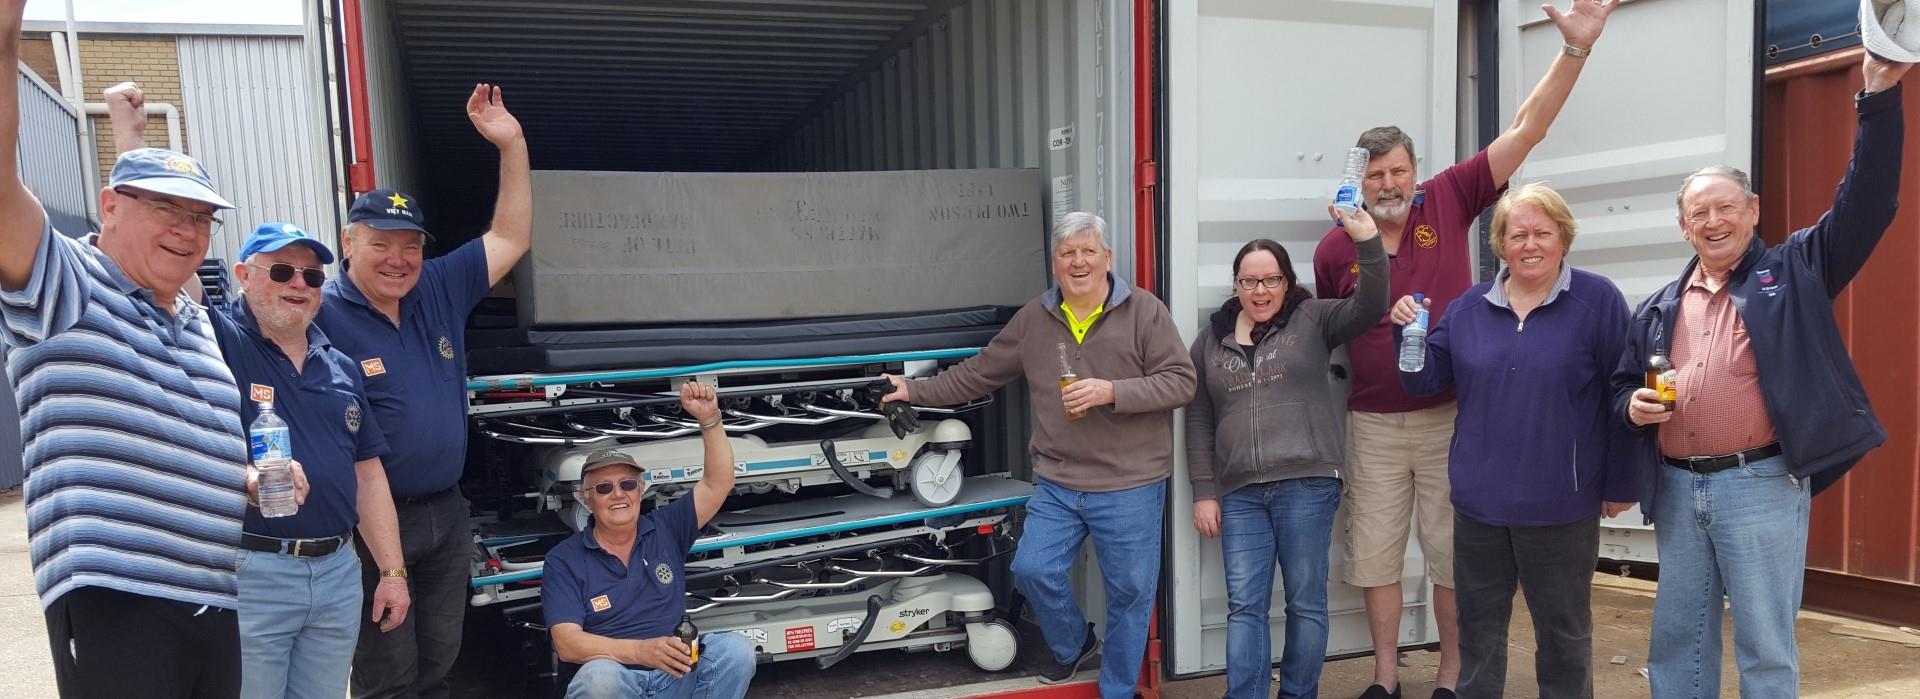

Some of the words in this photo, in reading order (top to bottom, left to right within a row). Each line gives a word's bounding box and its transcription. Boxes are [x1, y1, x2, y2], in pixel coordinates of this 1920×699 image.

[997, 202, 1030, 218] TWO
[365, 361, 382, 373] MS
[253, 387, 271, 399] MS
[899, 608, 930, 618] stryker
